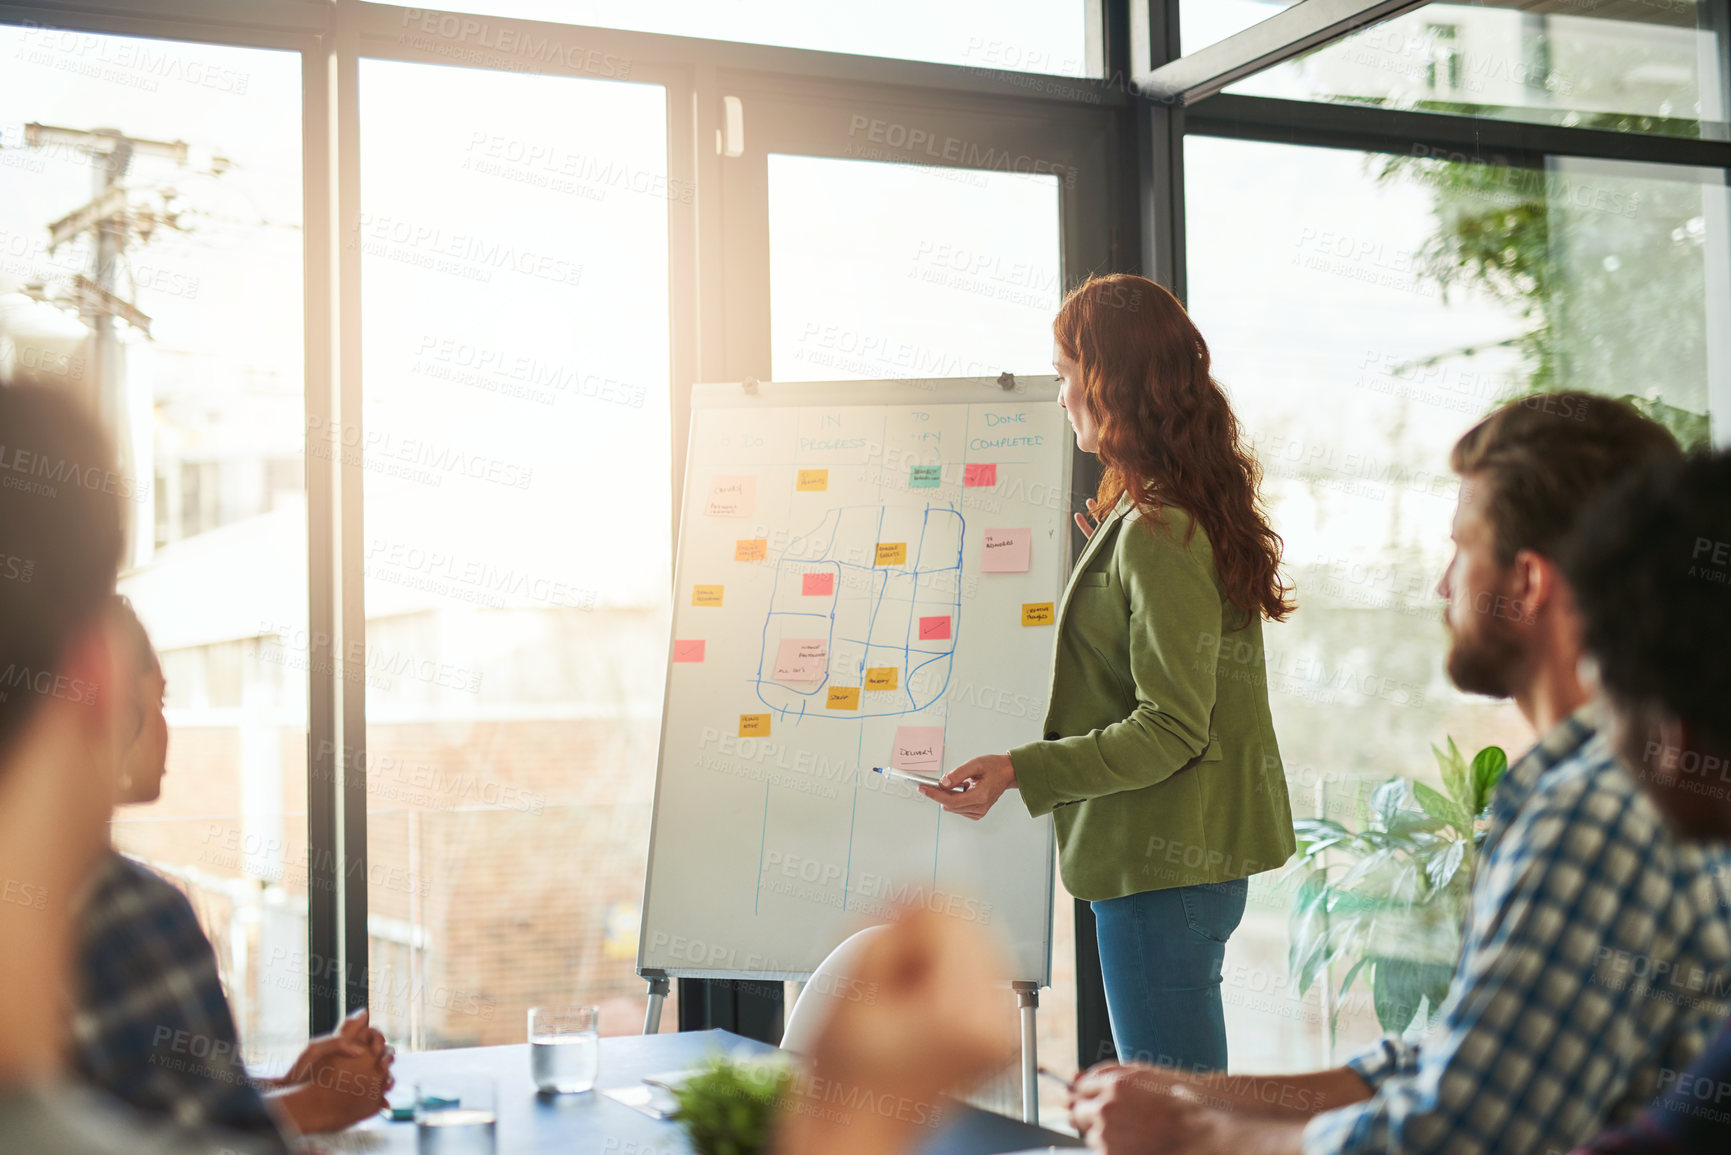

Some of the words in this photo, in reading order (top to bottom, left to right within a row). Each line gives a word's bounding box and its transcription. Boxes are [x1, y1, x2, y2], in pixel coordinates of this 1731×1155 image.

[820, 412, 841, 430] IN
[911, 411, 931, 421] TO
[984, 412, 1027, 427] DONE
[899, 746, 934, 758] DELIVERY
